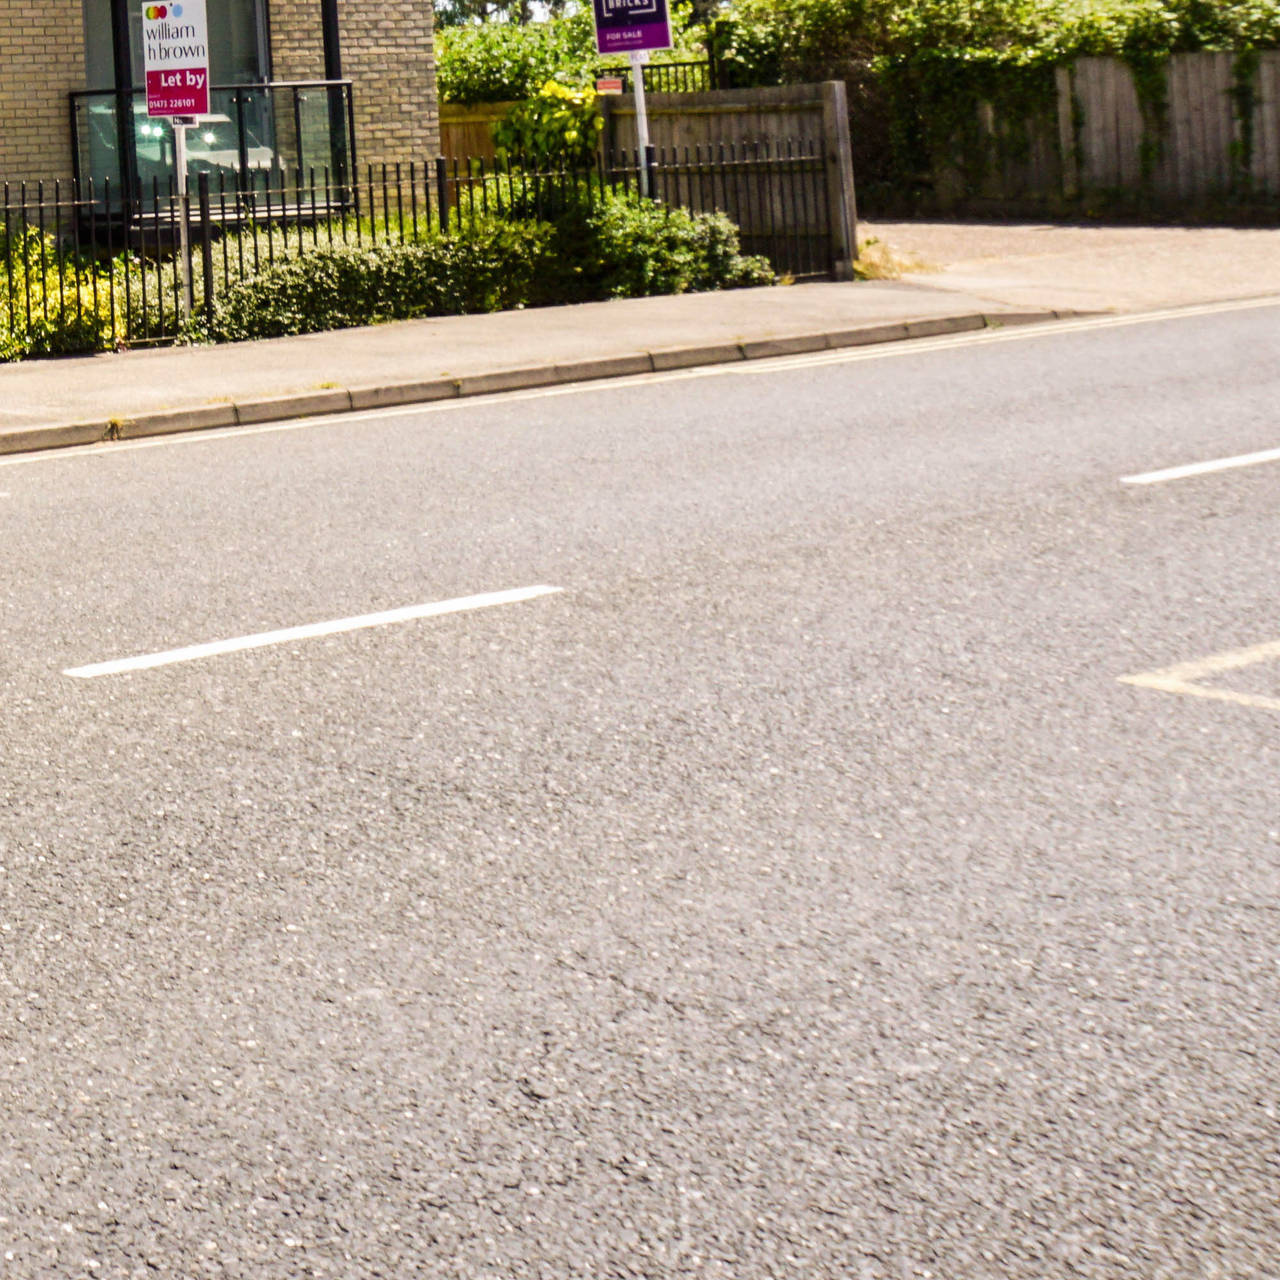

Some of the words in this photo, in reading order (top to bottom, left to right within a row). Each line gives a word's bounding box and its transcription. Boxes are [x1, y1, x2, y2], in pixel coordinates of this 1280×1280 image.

[146, 22, 195, 40] william
[606, 32, 621, 41] FOR
[622, 30, 643, 39] SALE
[148, 44, 156, 60] h
[158, 43, 206, 60] brown
[161, 73, 182, 87] Let
[186, 71, 205, 88] by
[169, 98, 195, 108] 226101
